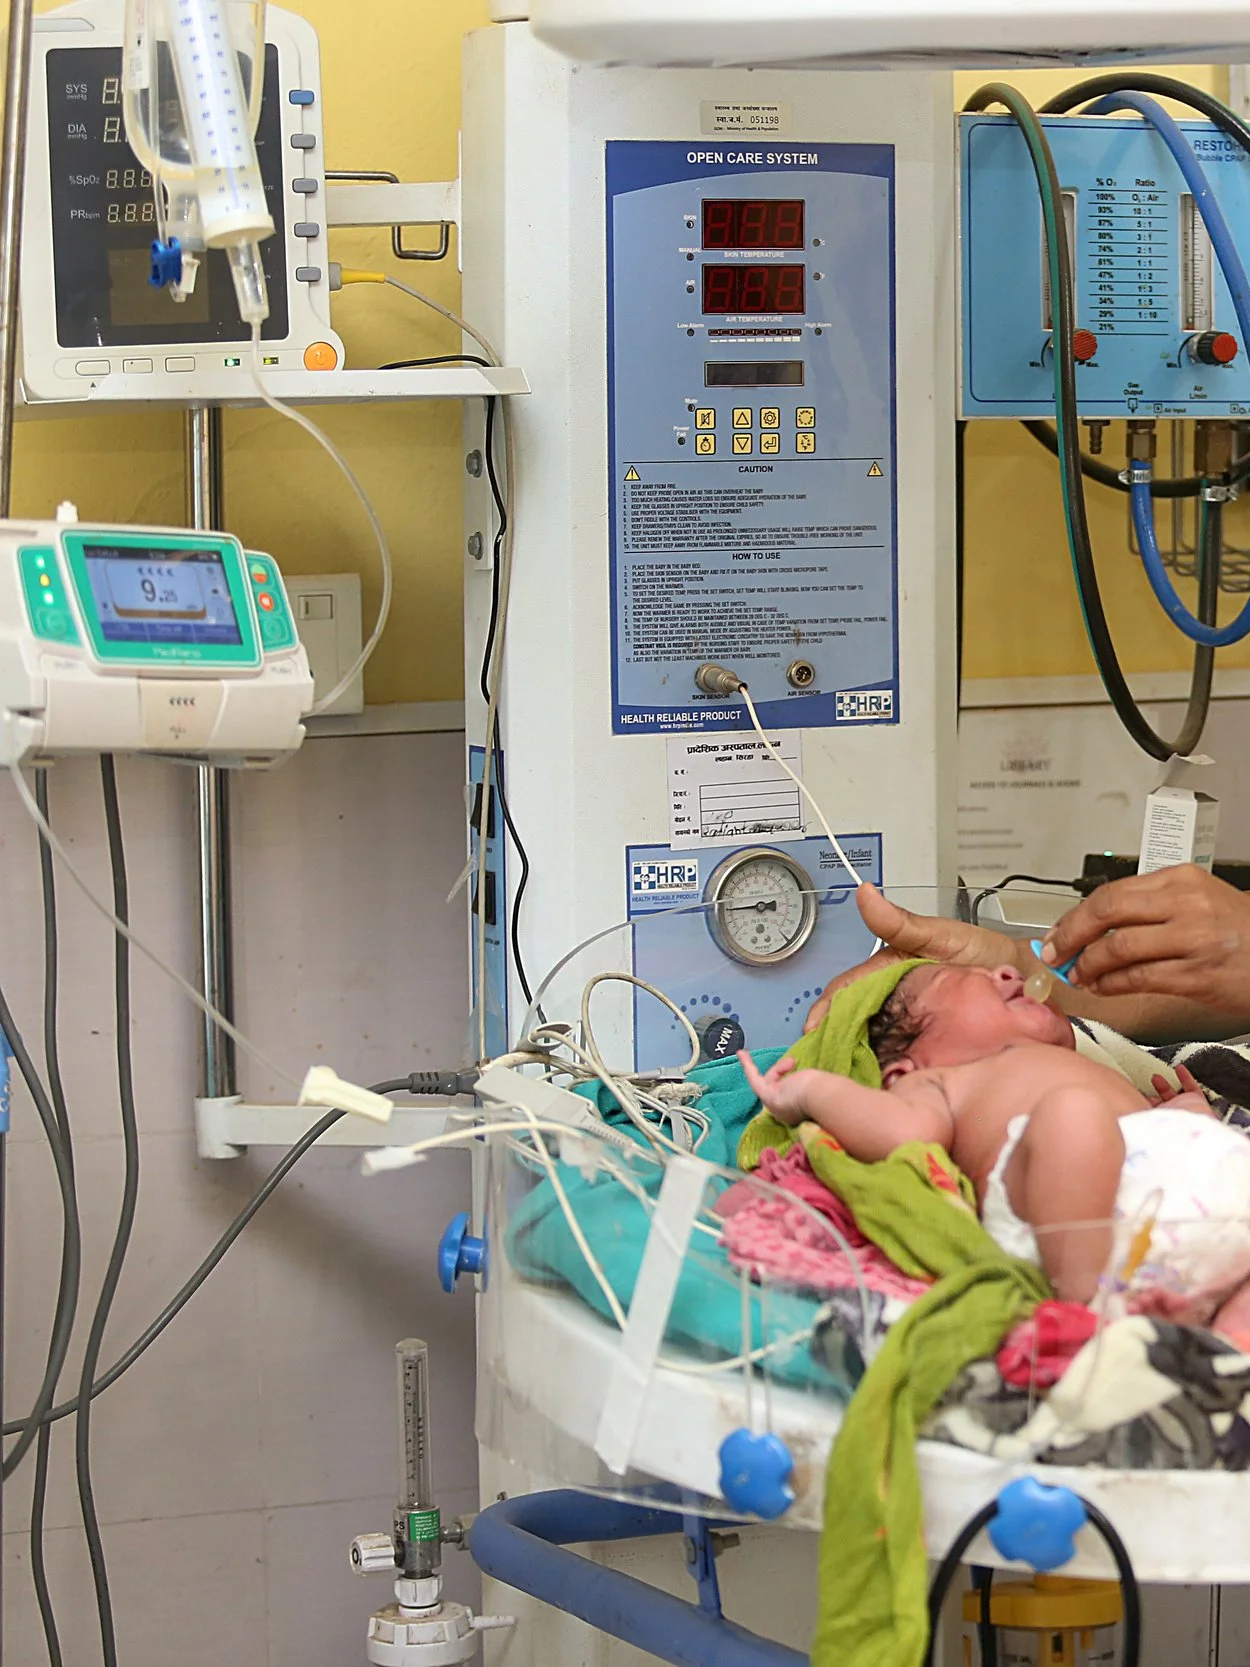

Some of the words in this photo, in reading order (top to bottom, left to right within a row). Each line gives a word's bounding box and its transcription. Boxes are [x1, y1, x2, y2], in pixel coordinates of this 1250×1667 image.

[66, 84, 87, 93] SYS
[750, 116, 779, 124] 051198
[68, 124, 86, 134] DIA
[687, 152, 723, 163] OPEN
[727, 152, 763, 163] CARE
[767, 153, 818, 164] SYSTEM
[1198, 153, 1222, 161] Bubble
[1135, 179, 1155, 187] Ratio
[857, 696, 892, 711] HRP
[621, 714, 655, 724] HEALTH
[656, 713, 698, 722] RELIABLE
[700, 711, 741, 720] PRODUCT
[687, 743, 719, 754] प्रादेशिक
[657, 865, 697, 883] HRP
[715, 1026, 732, 1055] MAX
